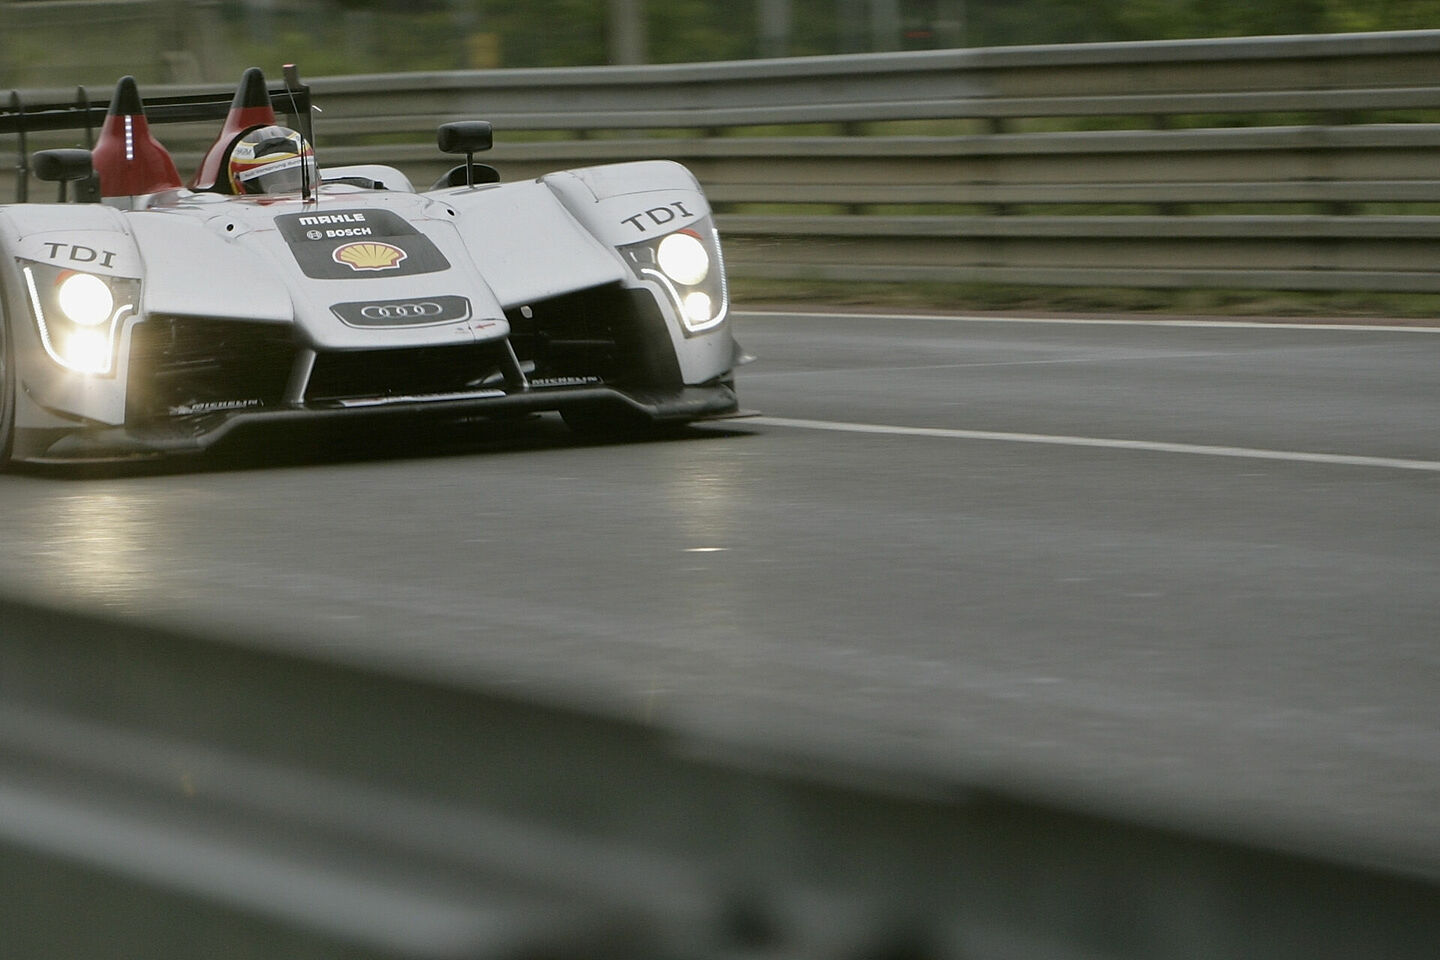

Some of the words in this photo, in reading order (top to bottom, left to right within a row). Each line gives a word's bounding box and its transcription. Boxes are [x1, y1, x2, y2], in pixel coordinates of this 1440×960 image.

[299, 213, 366, 226] MAHLE
[620, 201, 694, 232] TDI
[326, 227, 372, 238] BOSCH
[44, 242, 117, 269] TDI
[531, 376, 598, 387] MICHELIN
[191, 399, 258, 412] MICHELIN
